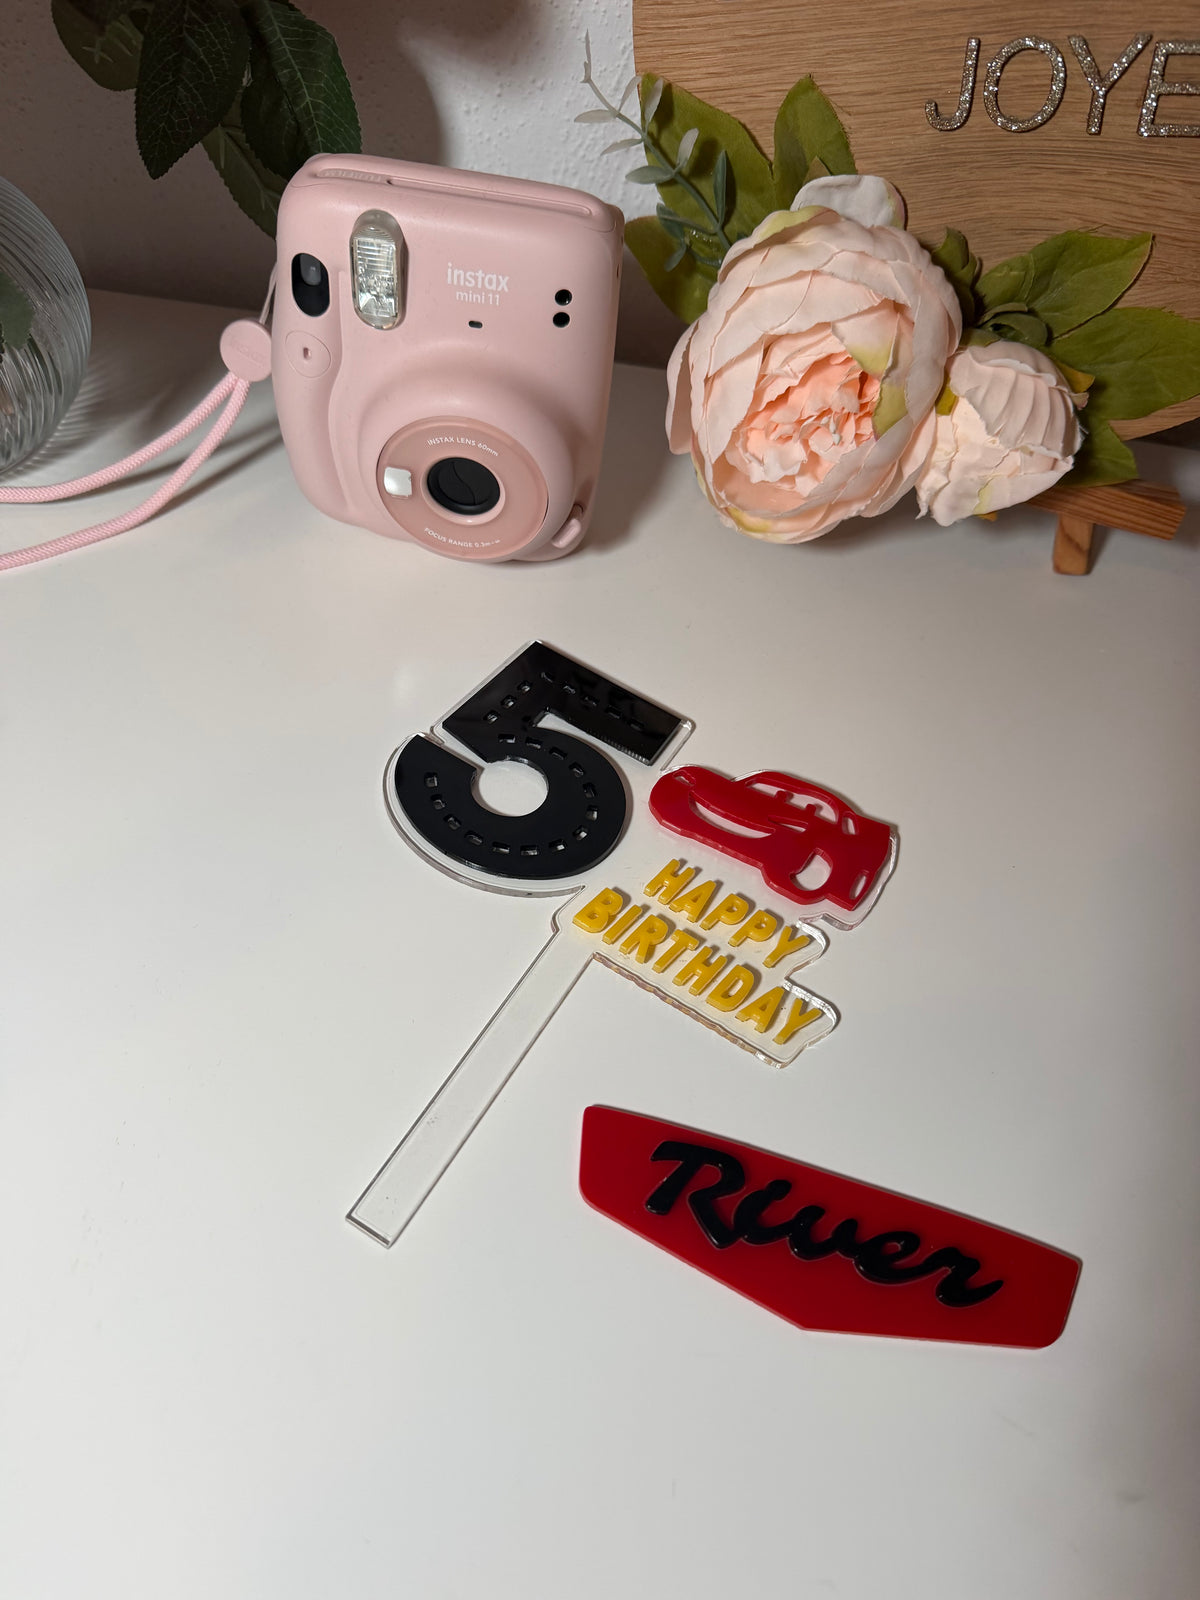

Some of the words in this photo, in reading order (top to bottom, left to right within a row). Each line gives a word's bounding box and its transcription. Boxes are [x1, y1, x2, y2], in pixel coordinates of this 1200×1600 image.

[925, 32, 1200, 137] JOYE
[447, 262, 510, 292] instax
[456, 290, 485, 304] mini
[488, 293, 500, 306] 11
[427, 436, 455, 446] INSTAX
[456, 437, 476, 446] LENS
[477, 442, 498, 456] 60mm
[424, 527, 447, 542] FOCUS
[448, 538, 473, 548] RANGE
[395, 641, 682, 880] 5
[572, 887, 824, 1045] BIRTHDAY
[643, 859, 812, 968] HAPPY
[645, 1140, 1005, 1309] River
